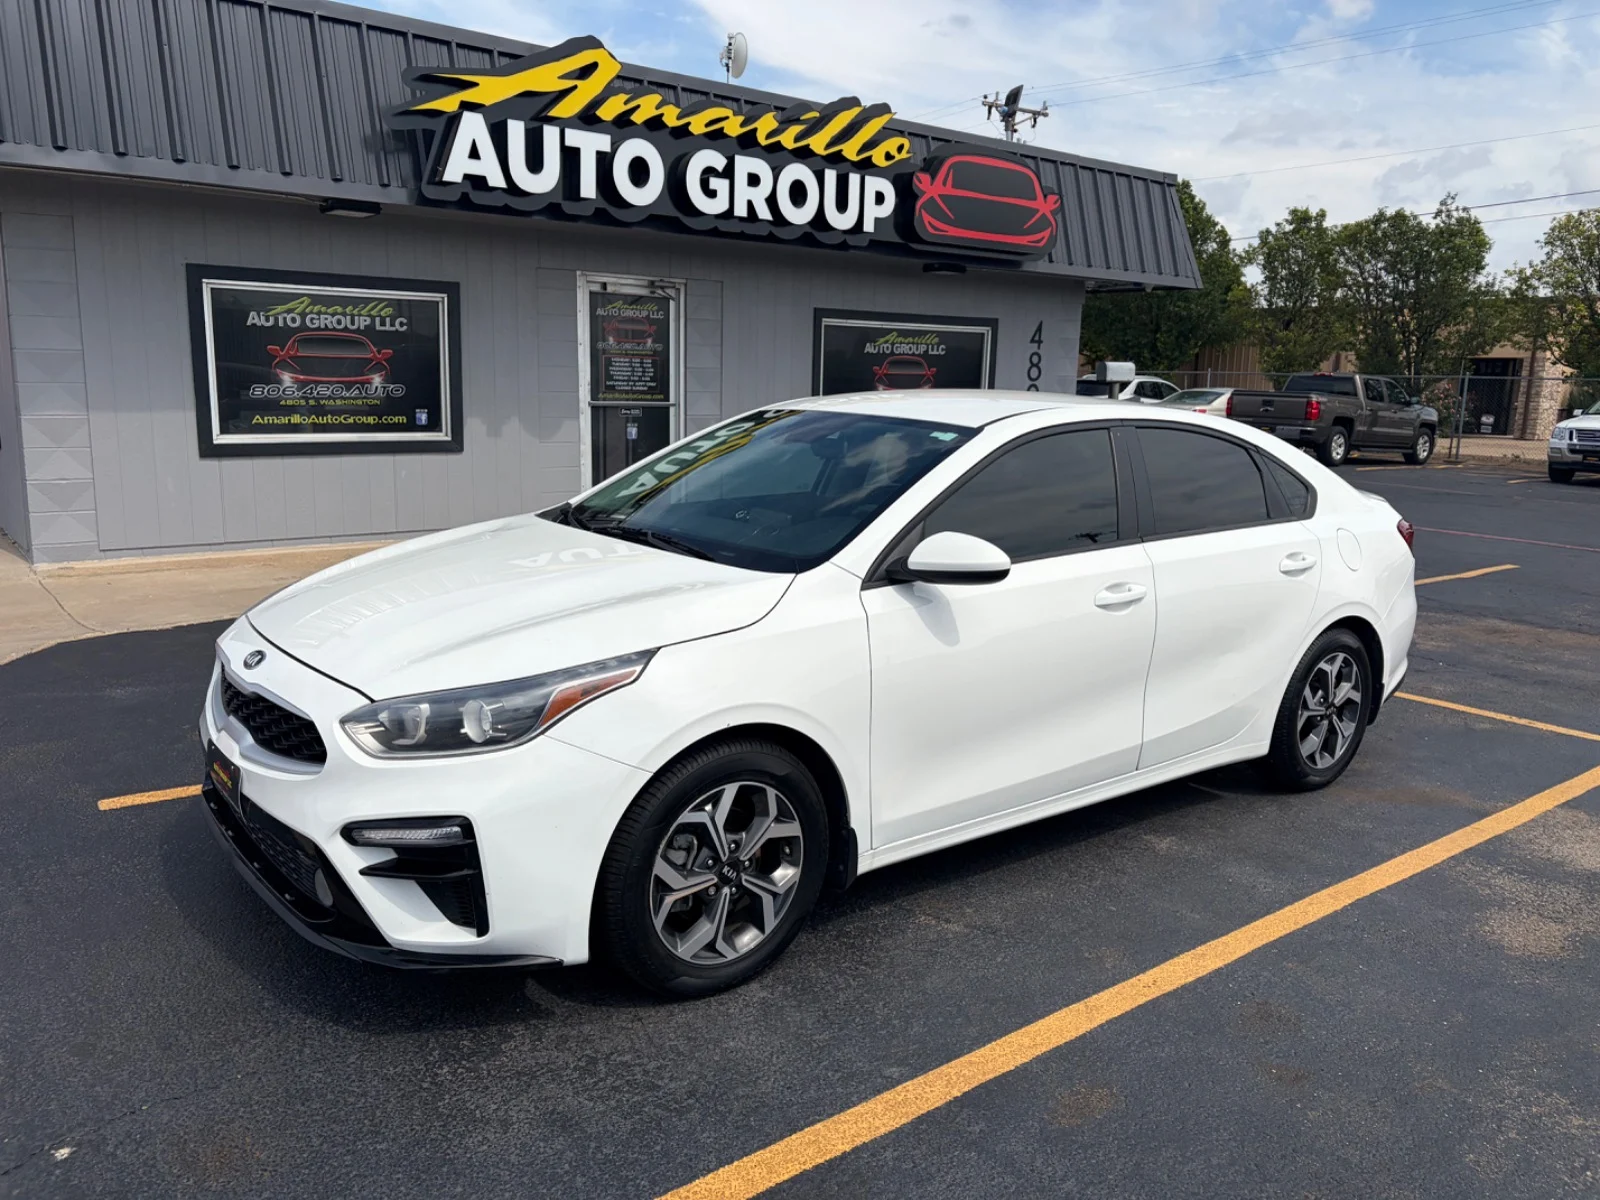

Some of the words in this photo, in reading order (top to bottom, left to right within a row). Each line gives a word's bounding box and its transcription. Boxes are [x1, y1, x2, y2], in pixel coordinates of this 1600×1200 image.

[410, 47, 912, 168] Amarillo
[441, 111, 664, 206] AUTO
[685, 149, 896, 233] GROUP
[264, 296, 393, 317] Amarillo
[596, 308, 619, 316] AUTO
[620, 309, 649, 318] GROUP
[650, 311, 665, 319] LLC
[246, 311, 301, 327] AUTO
[305, 314, 371, 330] GROUP
[375, 317, 408, 332] LLC
[875, 331, 940, 345] Amarillo
[864, 342, 893, 354] AUTO
[893, 343, 927, 355] GROUP
[928, 345, 947, 356] LLC
[250, 383, 407, 398] 806.420.AUTO
[251, 413, 407, 425] AmarilloAutoGroup.com
[722, 865, 738, 880] KIA
